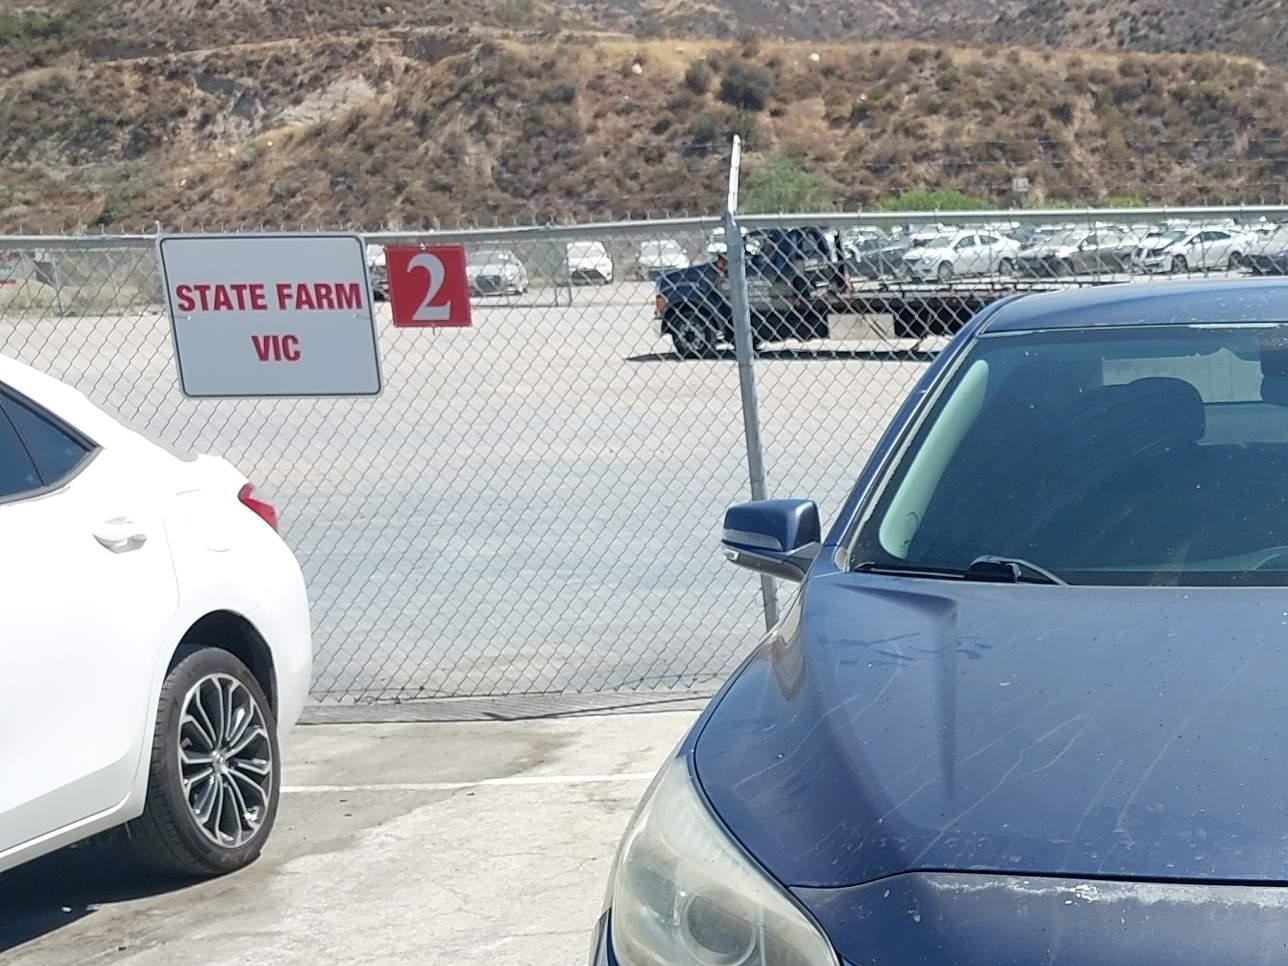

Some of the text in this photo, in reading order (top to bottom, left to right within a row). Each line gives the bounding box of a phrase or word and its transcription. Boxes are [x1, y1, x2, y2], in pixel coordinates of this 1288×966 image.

[175, 282, 363, 312] STATE FARM
[406, 252, 451, 321] 2
[251, 334, 302, 362] VIC
